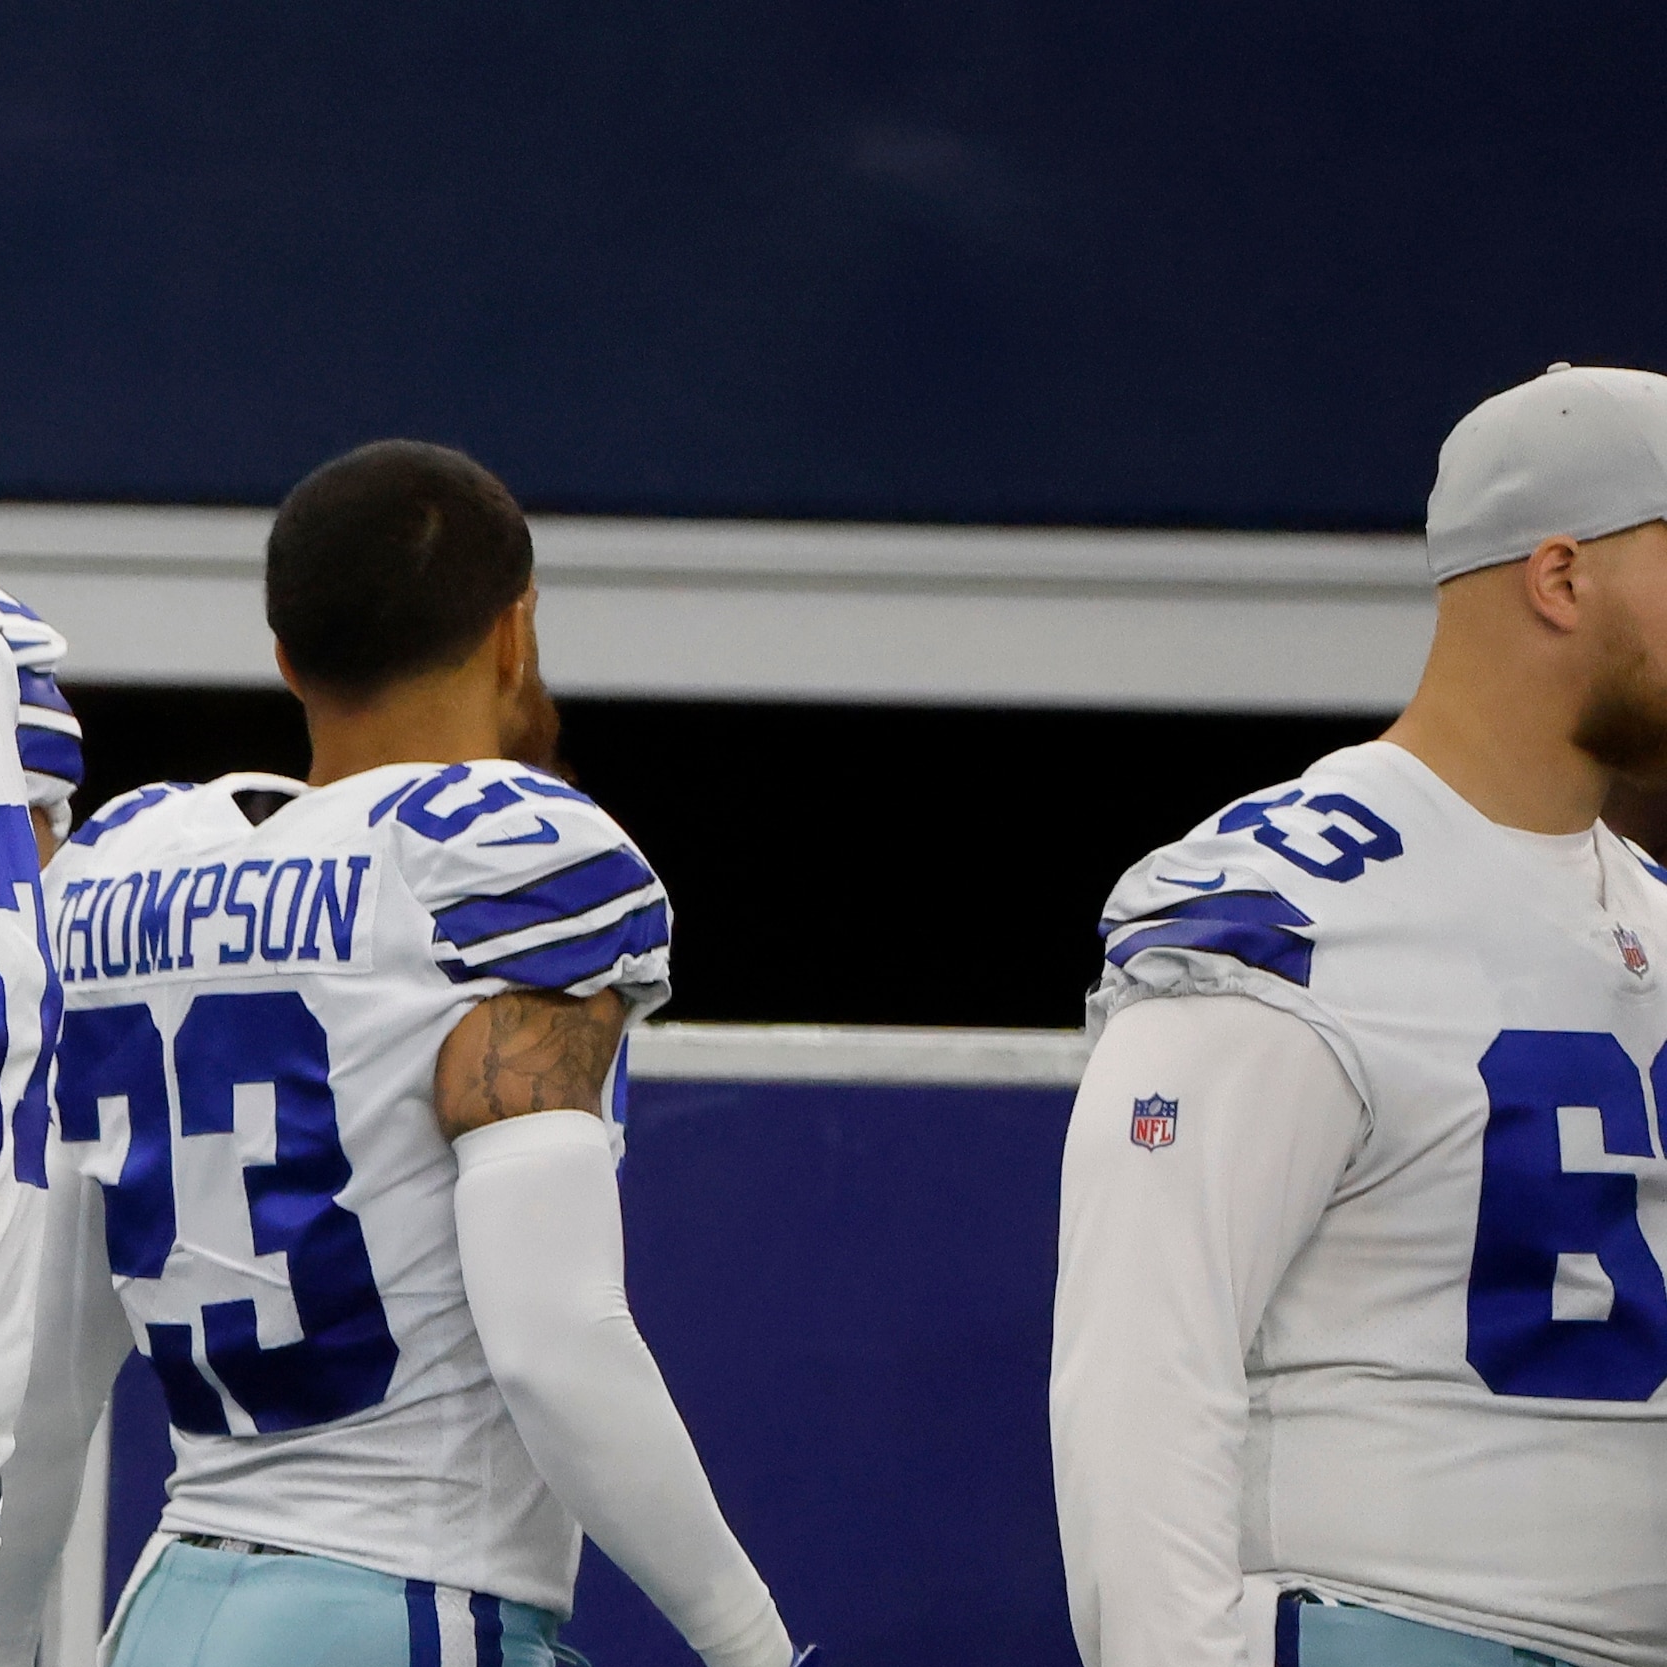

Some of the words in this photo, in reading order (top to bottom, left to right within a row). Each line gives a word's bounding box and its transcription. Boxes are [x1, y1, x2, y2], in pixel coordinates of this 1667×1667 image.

[53, 991, 400, 1437] 23
[1136, 1118, 1171, 1144] NFL
[1466, 1029, 1667, 1402] 6
